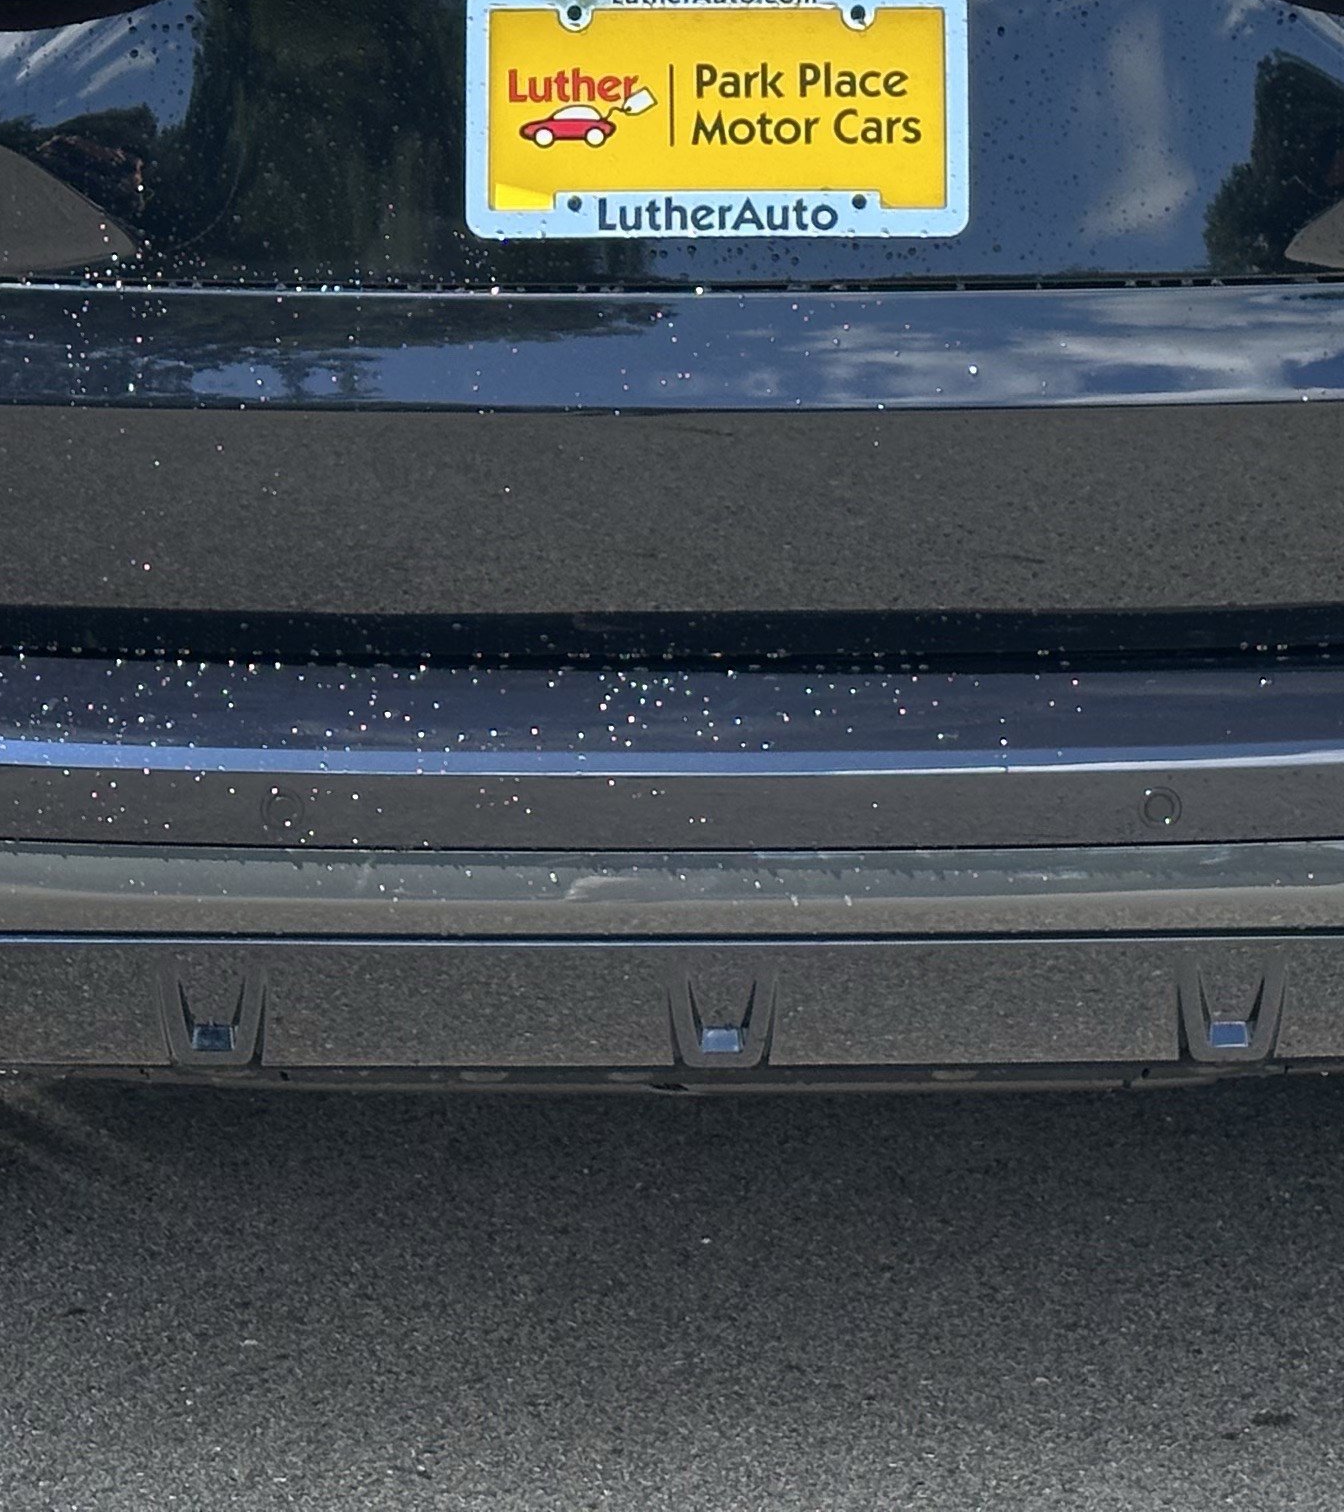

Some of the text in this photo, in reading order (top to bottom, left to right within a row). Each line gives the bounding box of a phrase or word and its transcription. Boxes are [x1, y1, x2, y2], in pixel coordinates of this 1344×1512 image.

[508, 67, 638, 103] Luther
[696, 62, 908, 98] Park Place
[691, 109, 922, 146] Motor Cars
[597, 196, 839, 232] LutherAuto
